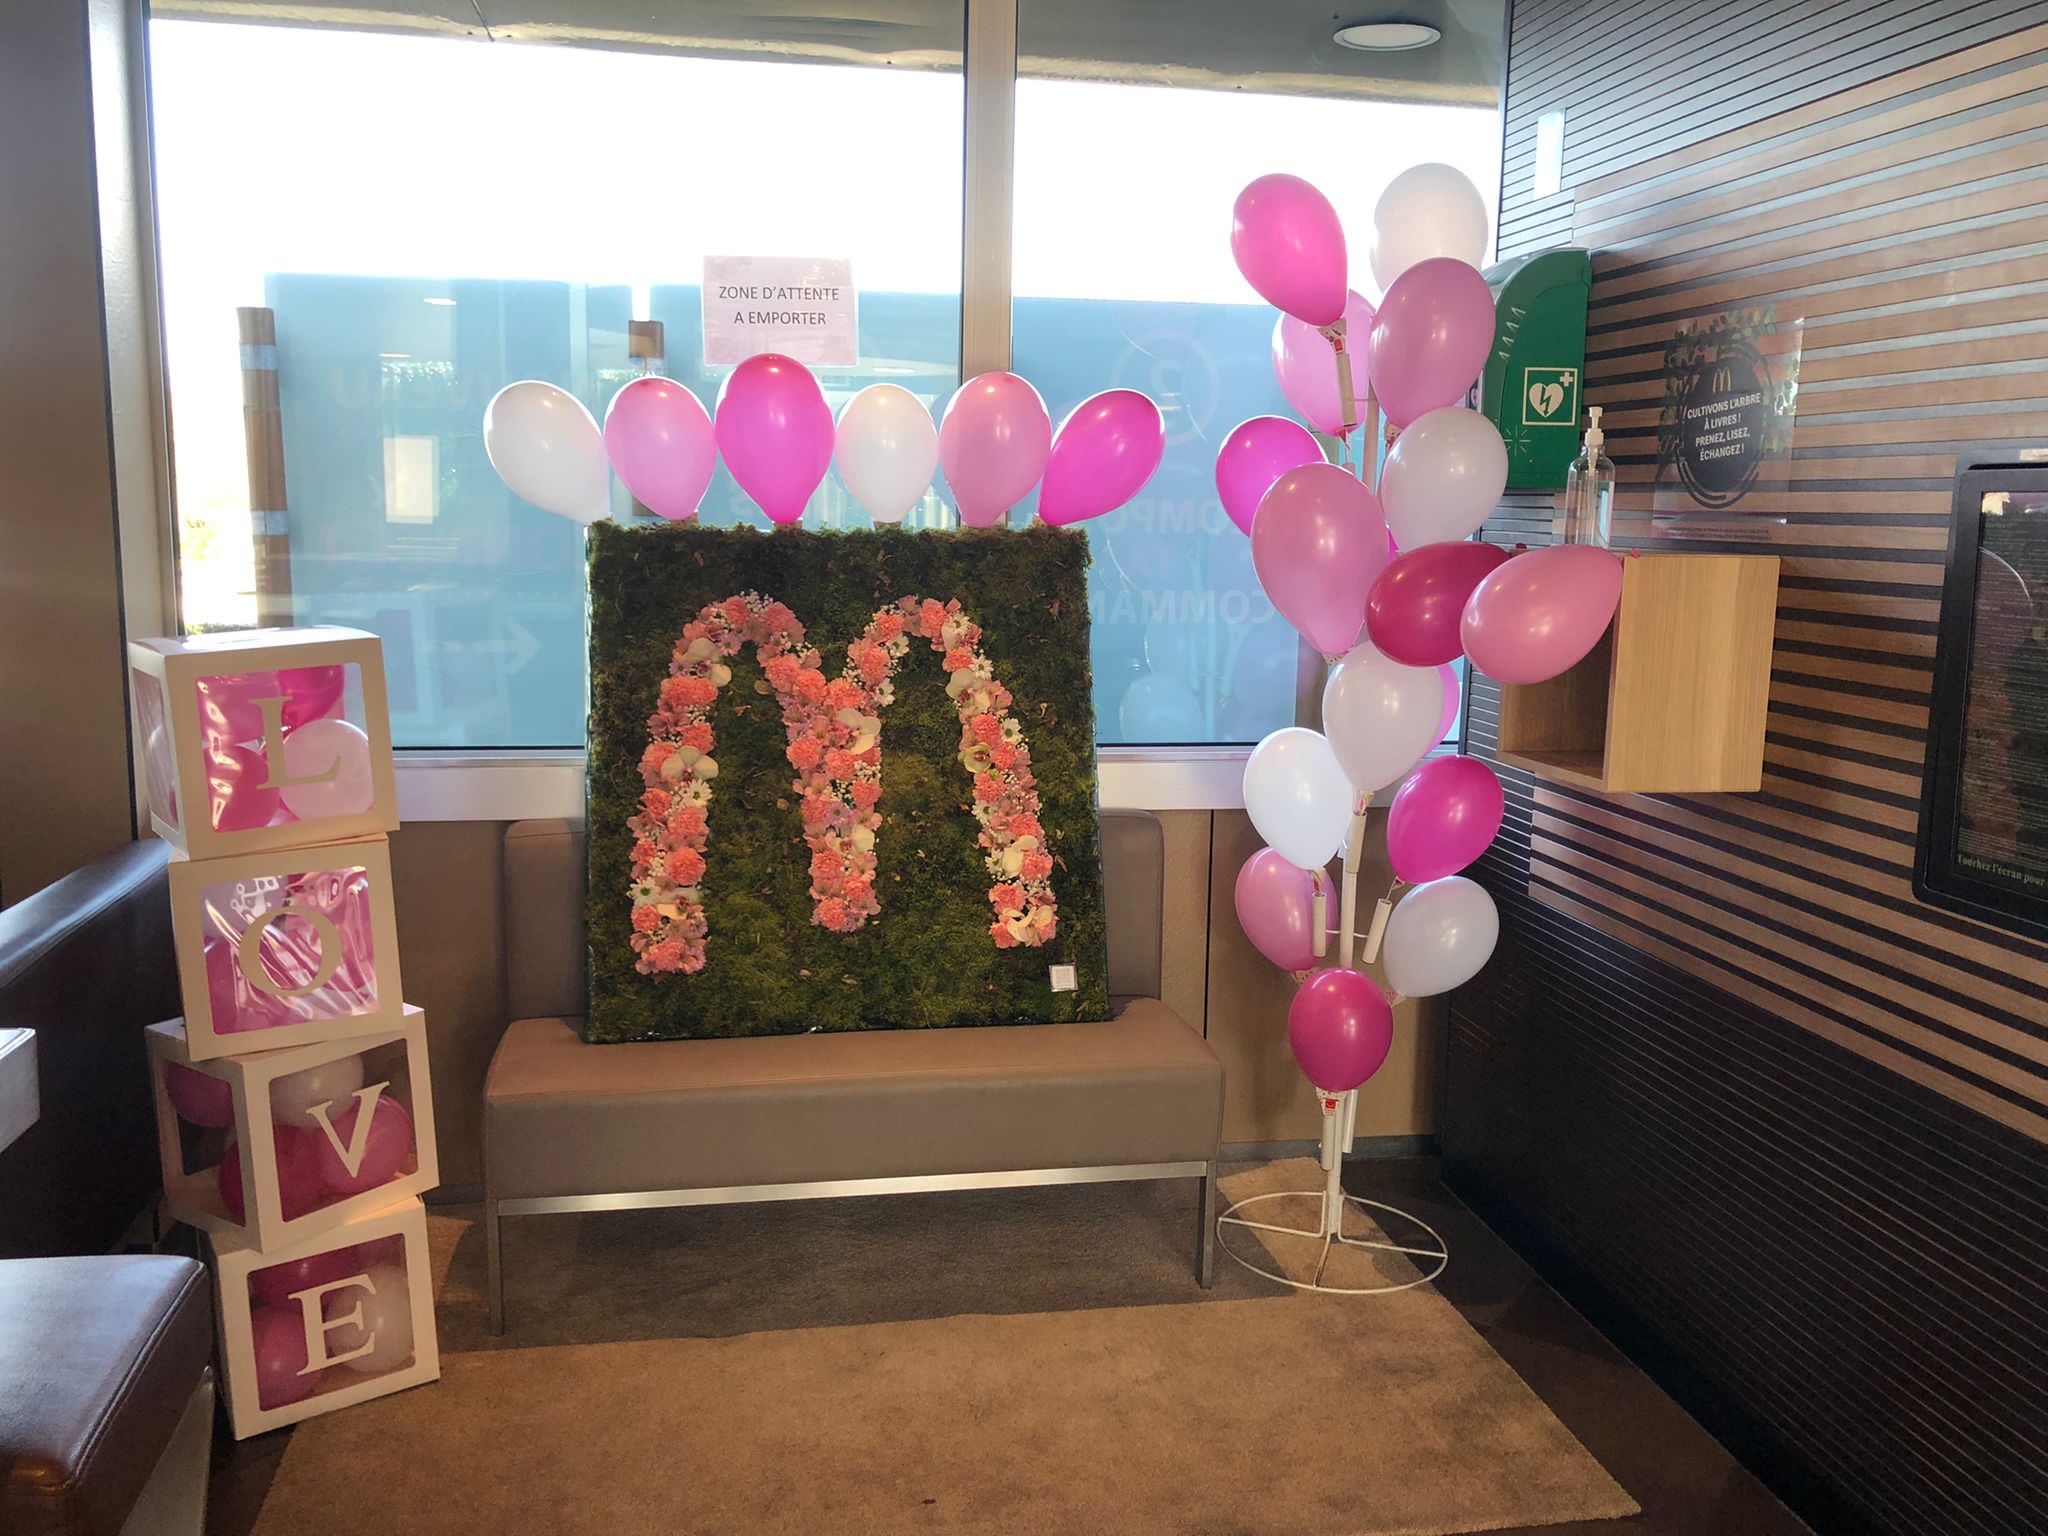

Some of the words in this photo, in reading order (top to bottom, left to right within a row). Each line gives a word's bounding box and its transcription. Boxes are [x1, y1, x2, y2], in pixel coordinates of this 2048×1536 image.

[719, 286, 758, 300] ZONE
[762, 286, 840, 301] D'ATTENTE
[734, 311, 745, 325] A
[748, 311, 827, 325] EMPORTER
[1687, 400, 1729, 420] CULTIVONS
